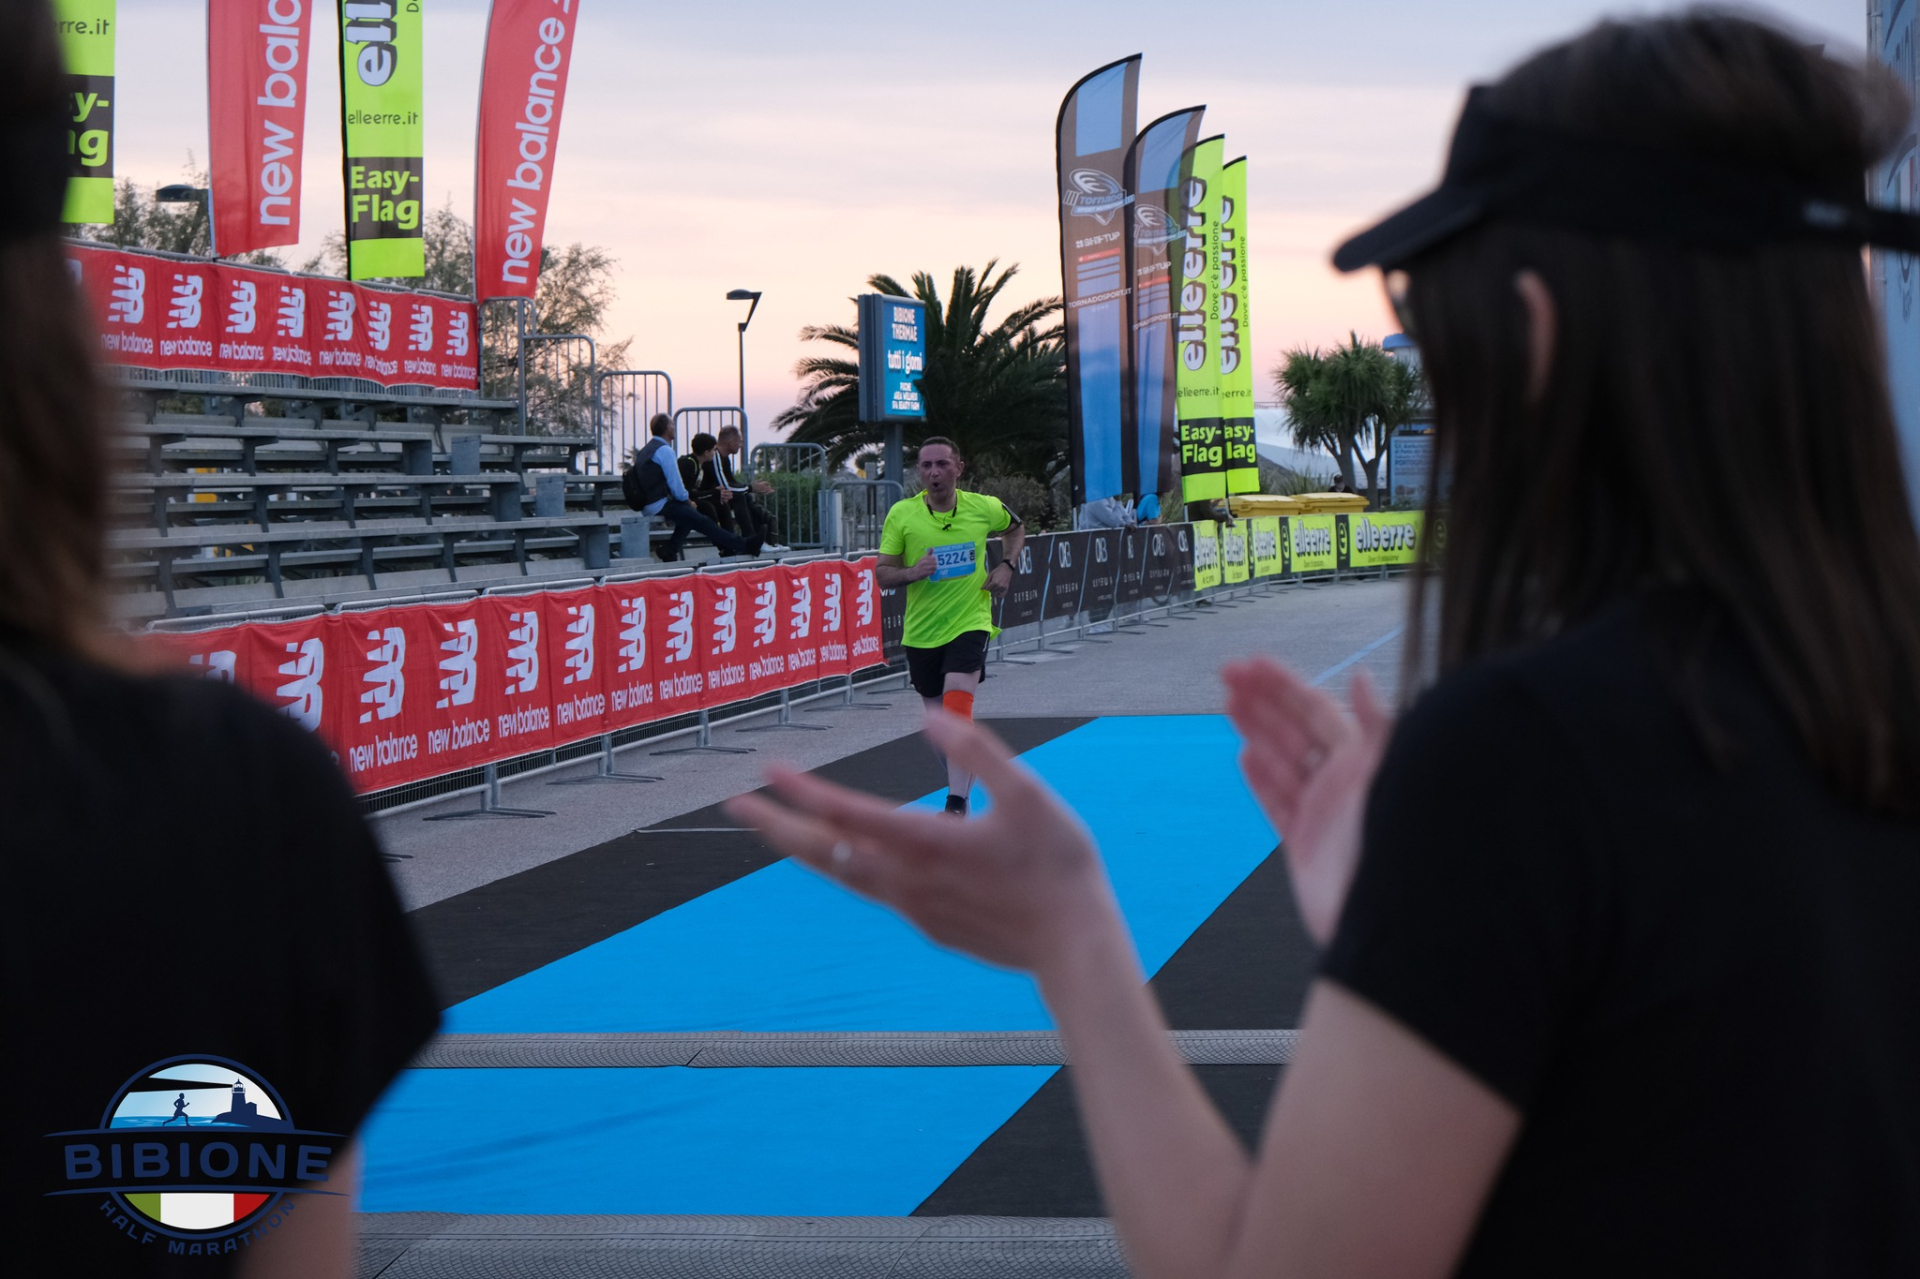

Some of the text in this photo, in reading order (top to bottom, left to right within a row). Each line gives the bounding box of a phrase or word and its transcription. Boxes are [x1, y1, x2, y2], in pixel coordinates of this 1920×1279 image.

[347, 110, 418, 125] elleerre.it
[502, 17, 565, 284] new balance
[260, 120, 295, 226] new
[351, 165, 419, 195] Easy-
[352, 194, 420, 230] Flag
[1211, 220, 1222, 271] passione
[1240, 235, 1249, 282] passione
[1178, 175, 1208, 372] elleerre
[1210, 291, 1220, 321] Dove
[1242, 302, 1250, 328] Dove
[121, 331, 153, 354] balance
[177, 336, 212, 357] balance
[1181, 424, 1222, 444] Easy-
[1225, 424, 1255, 442] asy-
[1182, 443, 1223, 467] Flag
[1226, 441, 1256, 463] lag
[1294, 519, 1331, 557] elleerre
[1355, 517, 1416, 553] elleerre
[937, 551, 967, 566] 5224
[660, 679, 674, 700] new
[708, 670, 721, 689] new
[611, 689, 628, 711] new
[498, 704, 549, 738] new balance
[557, 702, 574, 725] new
[349, 732, 418, 772] new balance
[428, 728, 451, 755] new
